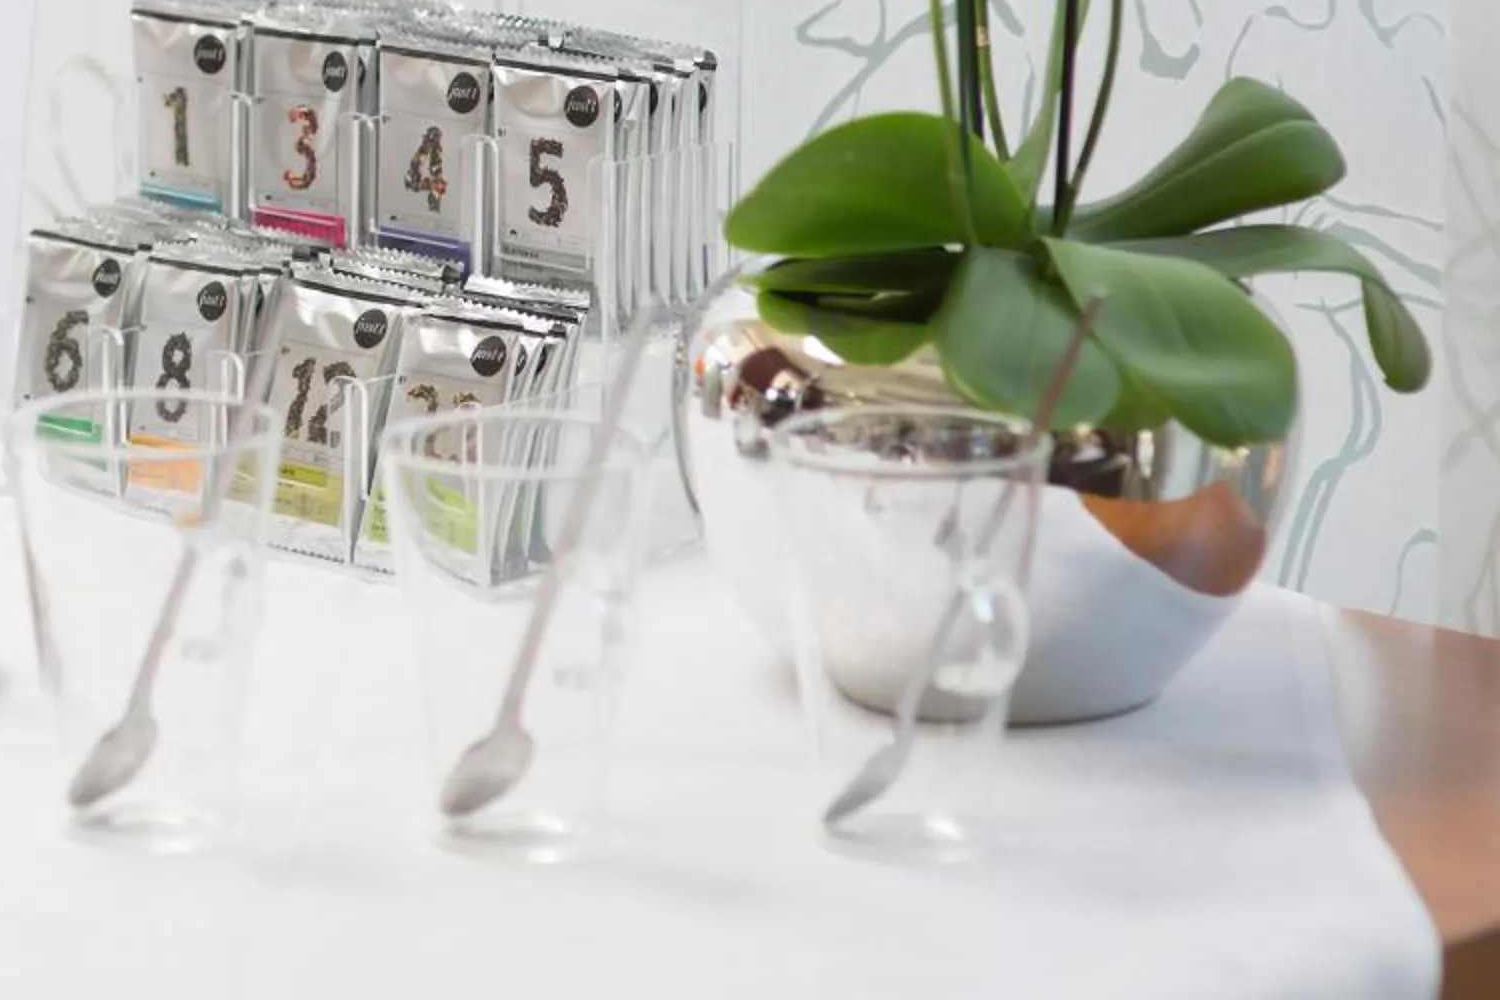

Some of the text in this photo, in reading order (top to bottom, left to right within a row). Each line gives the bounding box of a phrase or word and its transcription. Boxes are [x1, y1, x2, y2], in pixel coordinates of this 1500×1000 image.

[165, 86, 190, 167] 1
[282, 104, 320, 191] 3
[404, 126, 447, 213] 4
[528, 137, 570, 228] 5
[45, 310, 89, 393] 6
[156, 331, 194, 423] 8
[283, 357, 357, 446] 12
